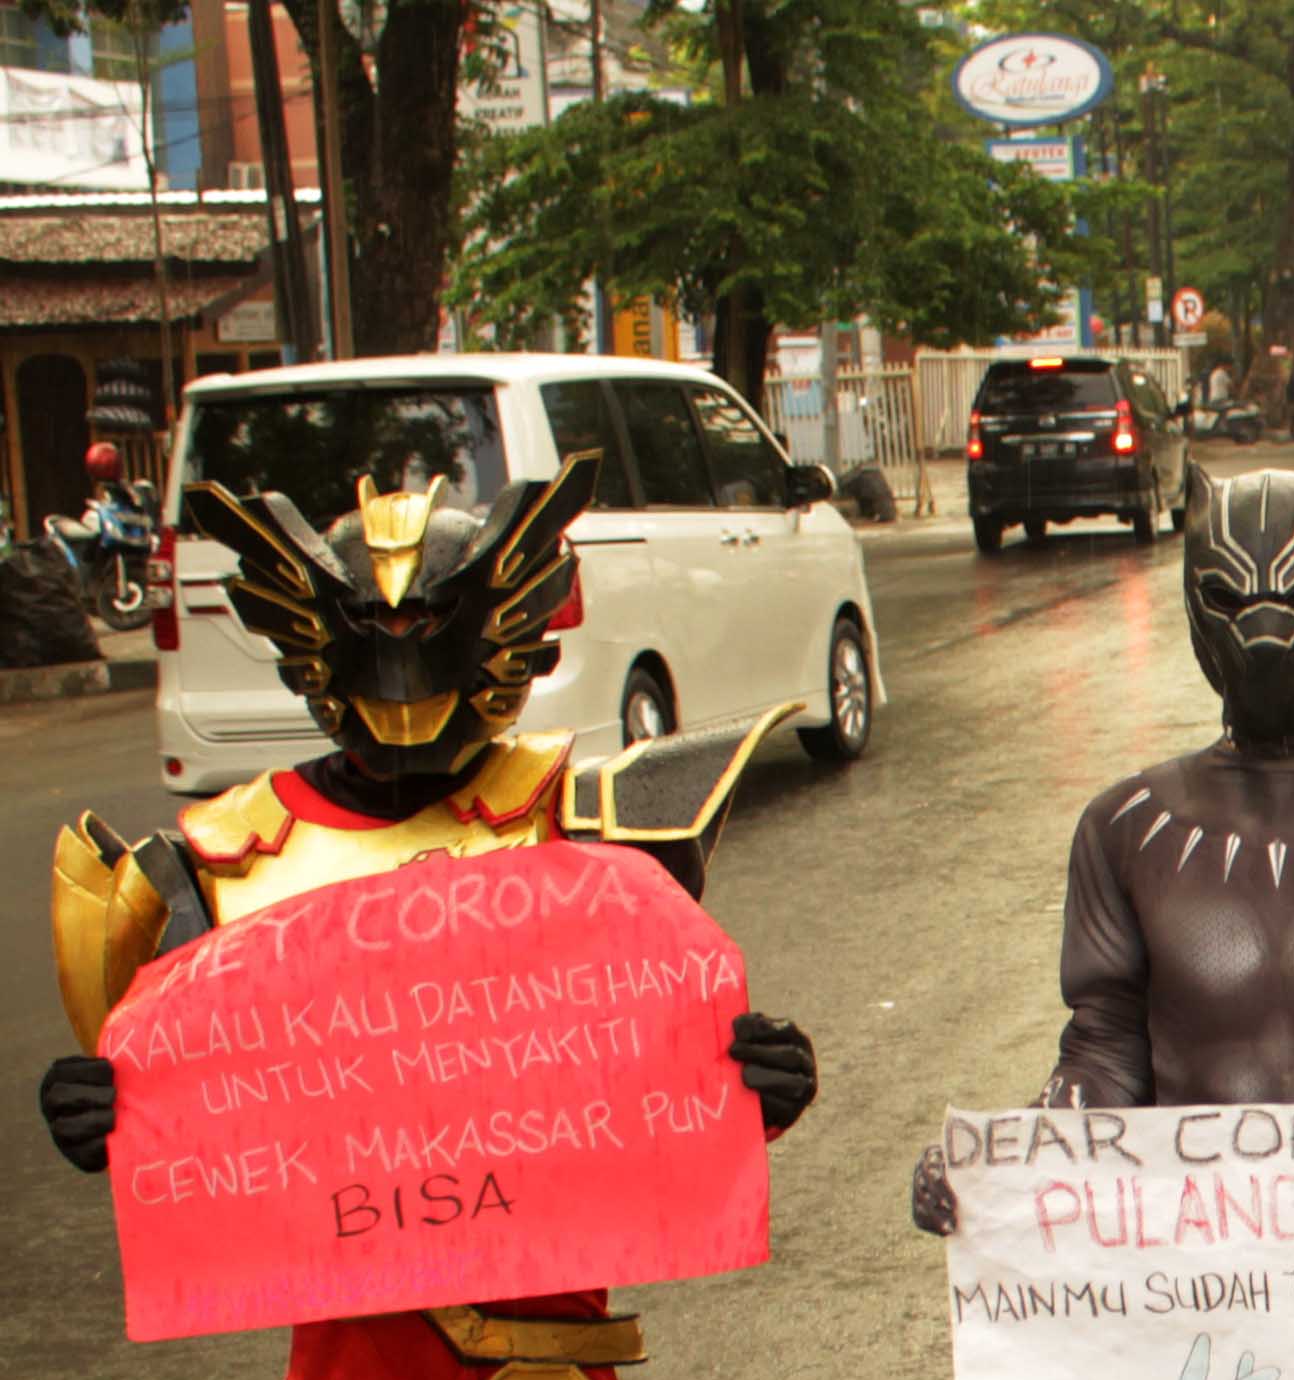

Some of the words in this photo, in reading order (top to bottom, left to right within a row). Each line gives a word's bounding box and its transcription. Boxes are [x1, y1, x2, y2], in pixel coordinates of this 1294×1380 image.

[346, 862, 640, 951] CORONA
[106, 1001, 267, 1073] KALAU
[282, 991, 400, 1047] KAU
[411, 964, 600, 1029] DATANG
[605, 948, 740, 1004] HANYA
[202, 1054, 373, 1116] UNTUK
[391, 1017, 642, 1092] MENYAKITI
[132, 1140, 318, 1206] CEWEK
[345, 1100, 625, 1175] MAKASSAR
[641, 1082, 729, 1137] PUN
[944, 1110, 1144, 1170] DEAR
[331, 1171, 518, 1238] BISA
[954, 1280, 1129, 1324] MAINMU
[1143, 1270, 1271, 1314] SUDAH
